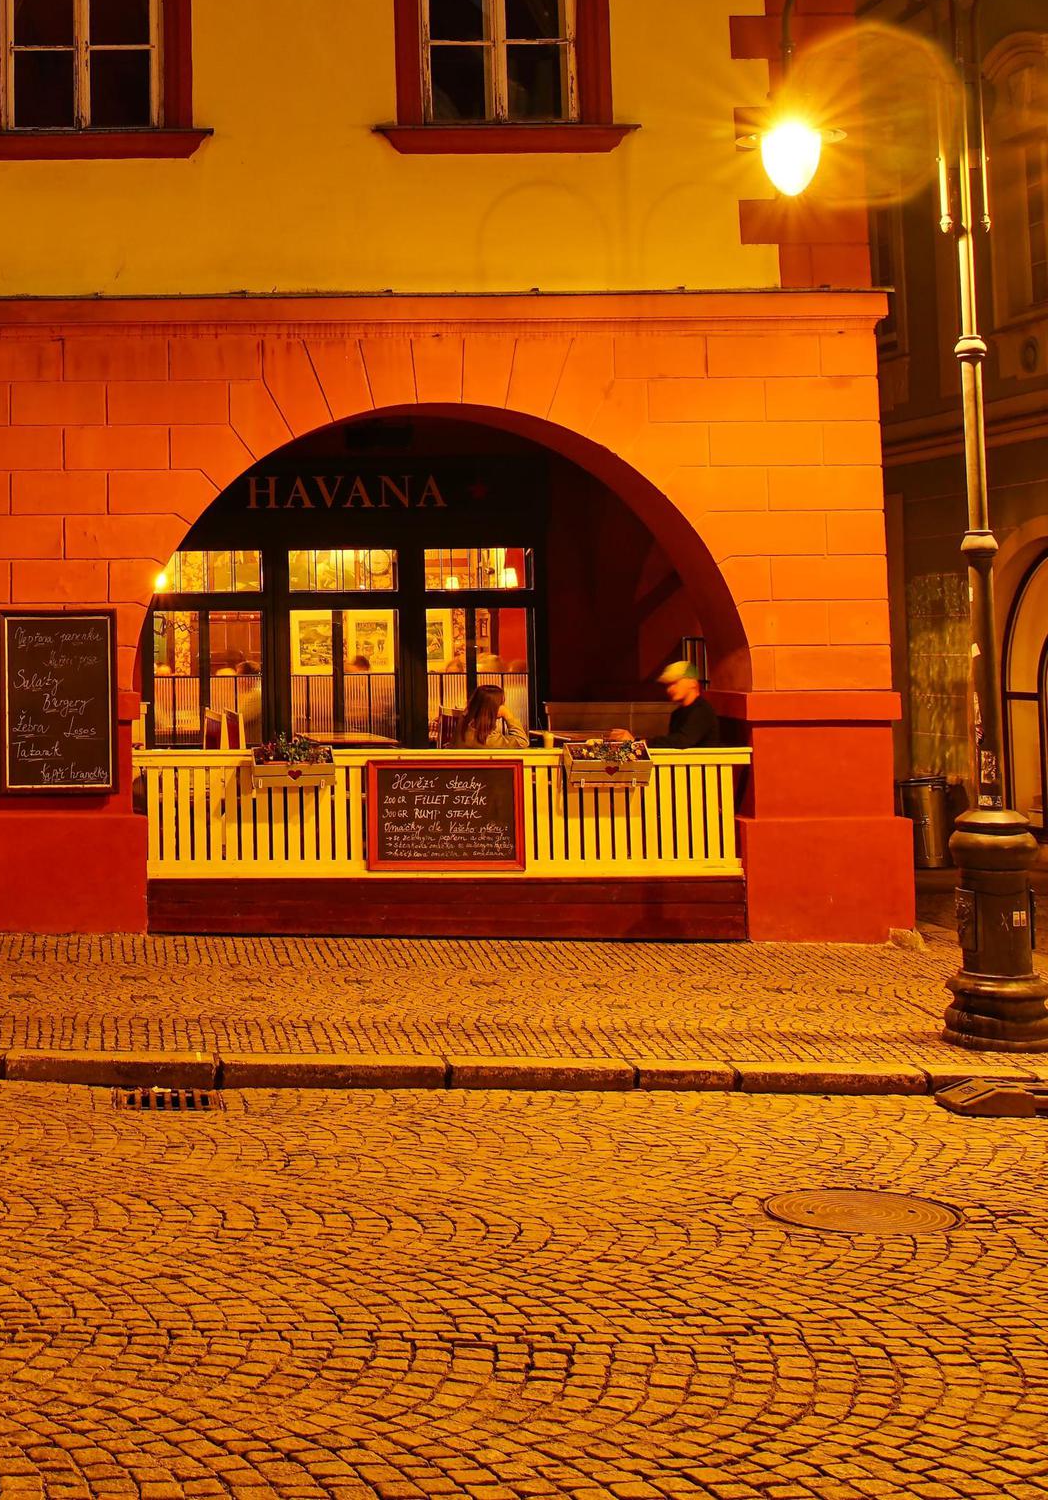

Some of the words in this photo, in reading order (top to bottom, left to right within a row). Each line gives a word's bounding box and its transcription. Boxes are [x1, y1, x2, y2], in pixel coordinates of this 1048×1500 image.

[246, 474, 449, 509] HAVANA
[12, 709, 51, 734] Žebra
[63, 716, 97, 737] Losos
[392, 773, 439, 790] Hovězí
[446, 775, 487, 799] steaky
[453, 795, 487, 806] STEAK
[414, 808, 441, 820] RUMP
[445, 809, 483, 819] STEAK
